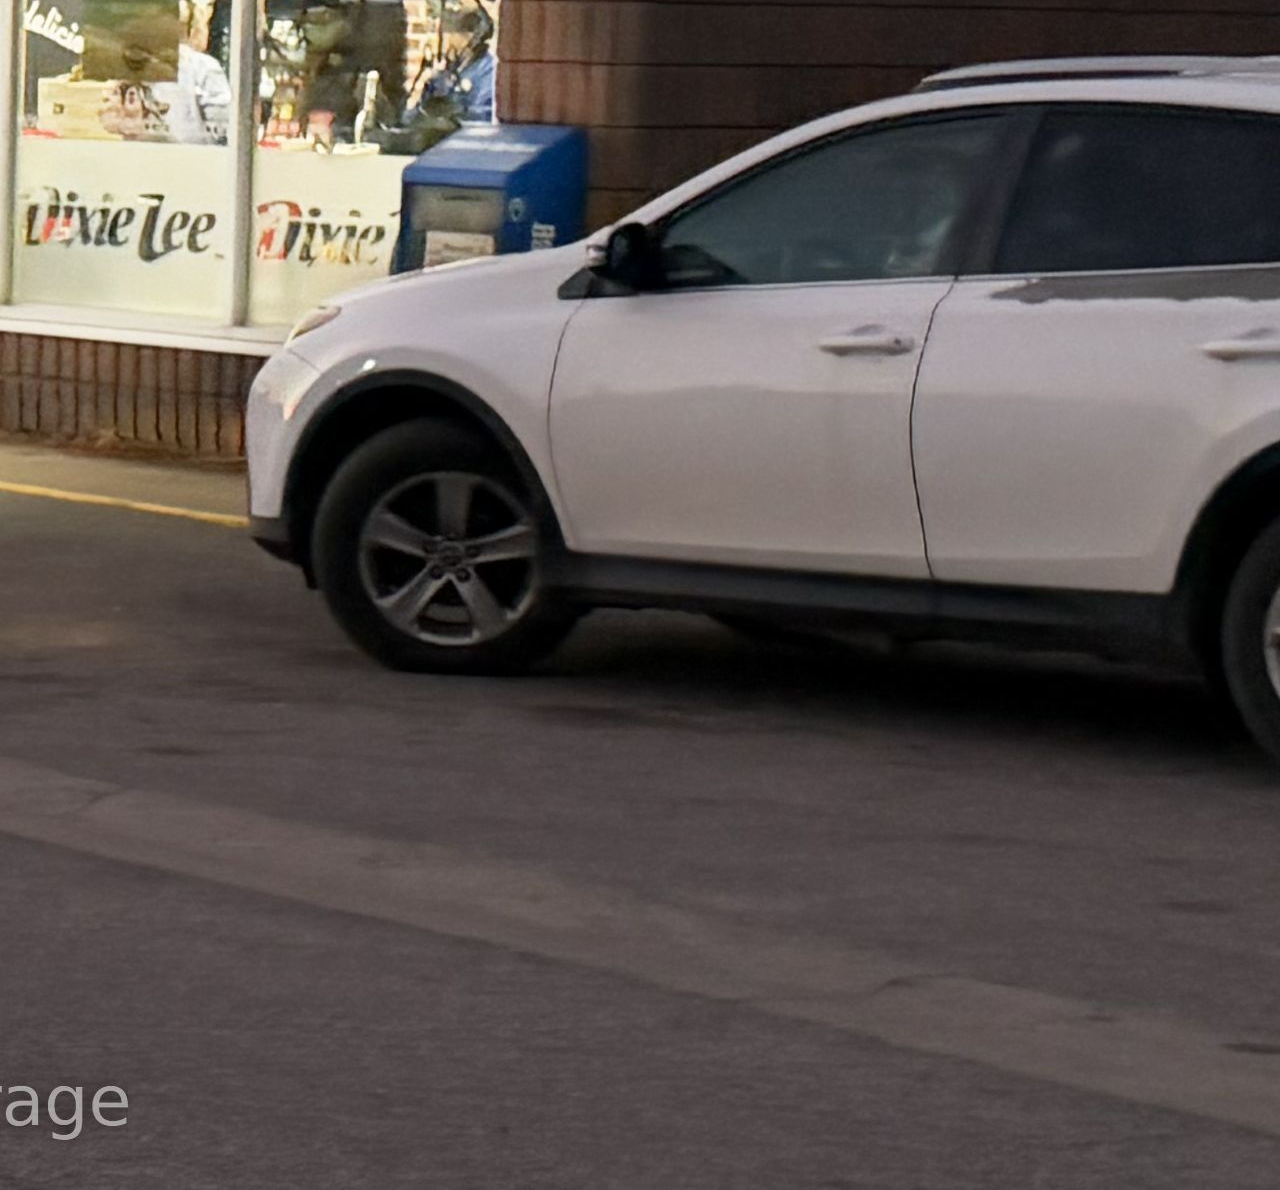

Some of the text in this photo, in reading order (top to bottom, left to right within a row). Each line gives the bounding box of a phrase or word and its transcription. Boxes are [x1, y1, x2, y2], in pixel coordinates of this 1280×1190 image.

[19, 186, 217, 263] Dixie Lee
[256, 200, 386, 268] Dixie
